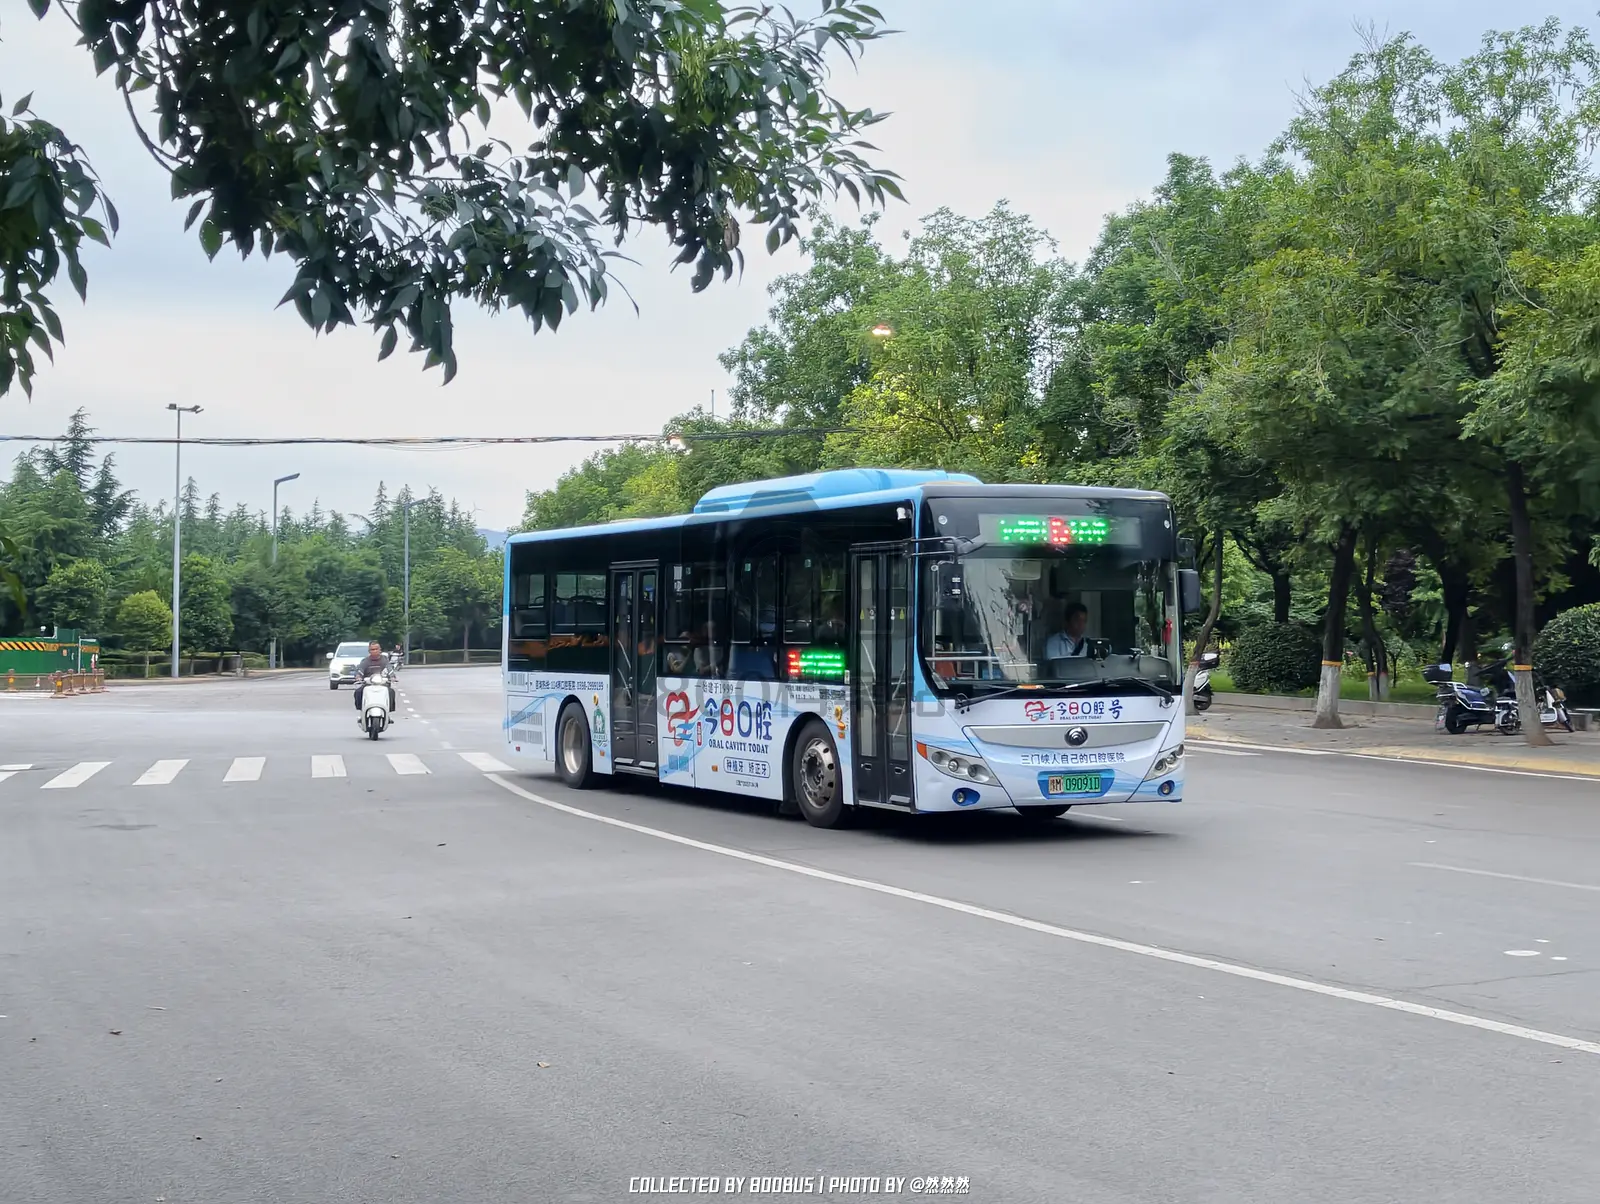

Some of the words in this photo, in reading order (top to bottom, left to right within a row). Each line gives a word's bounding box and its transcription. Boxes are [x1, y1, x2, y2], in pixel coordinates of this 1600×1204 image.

[709, 738, 724, 749] ORAL
[725, 741, 747, 752] CAVITY
[748, 743, 769, 754] TODAY
[1021, 752, 1126, 764] 三门峡人自己的口腔医院
